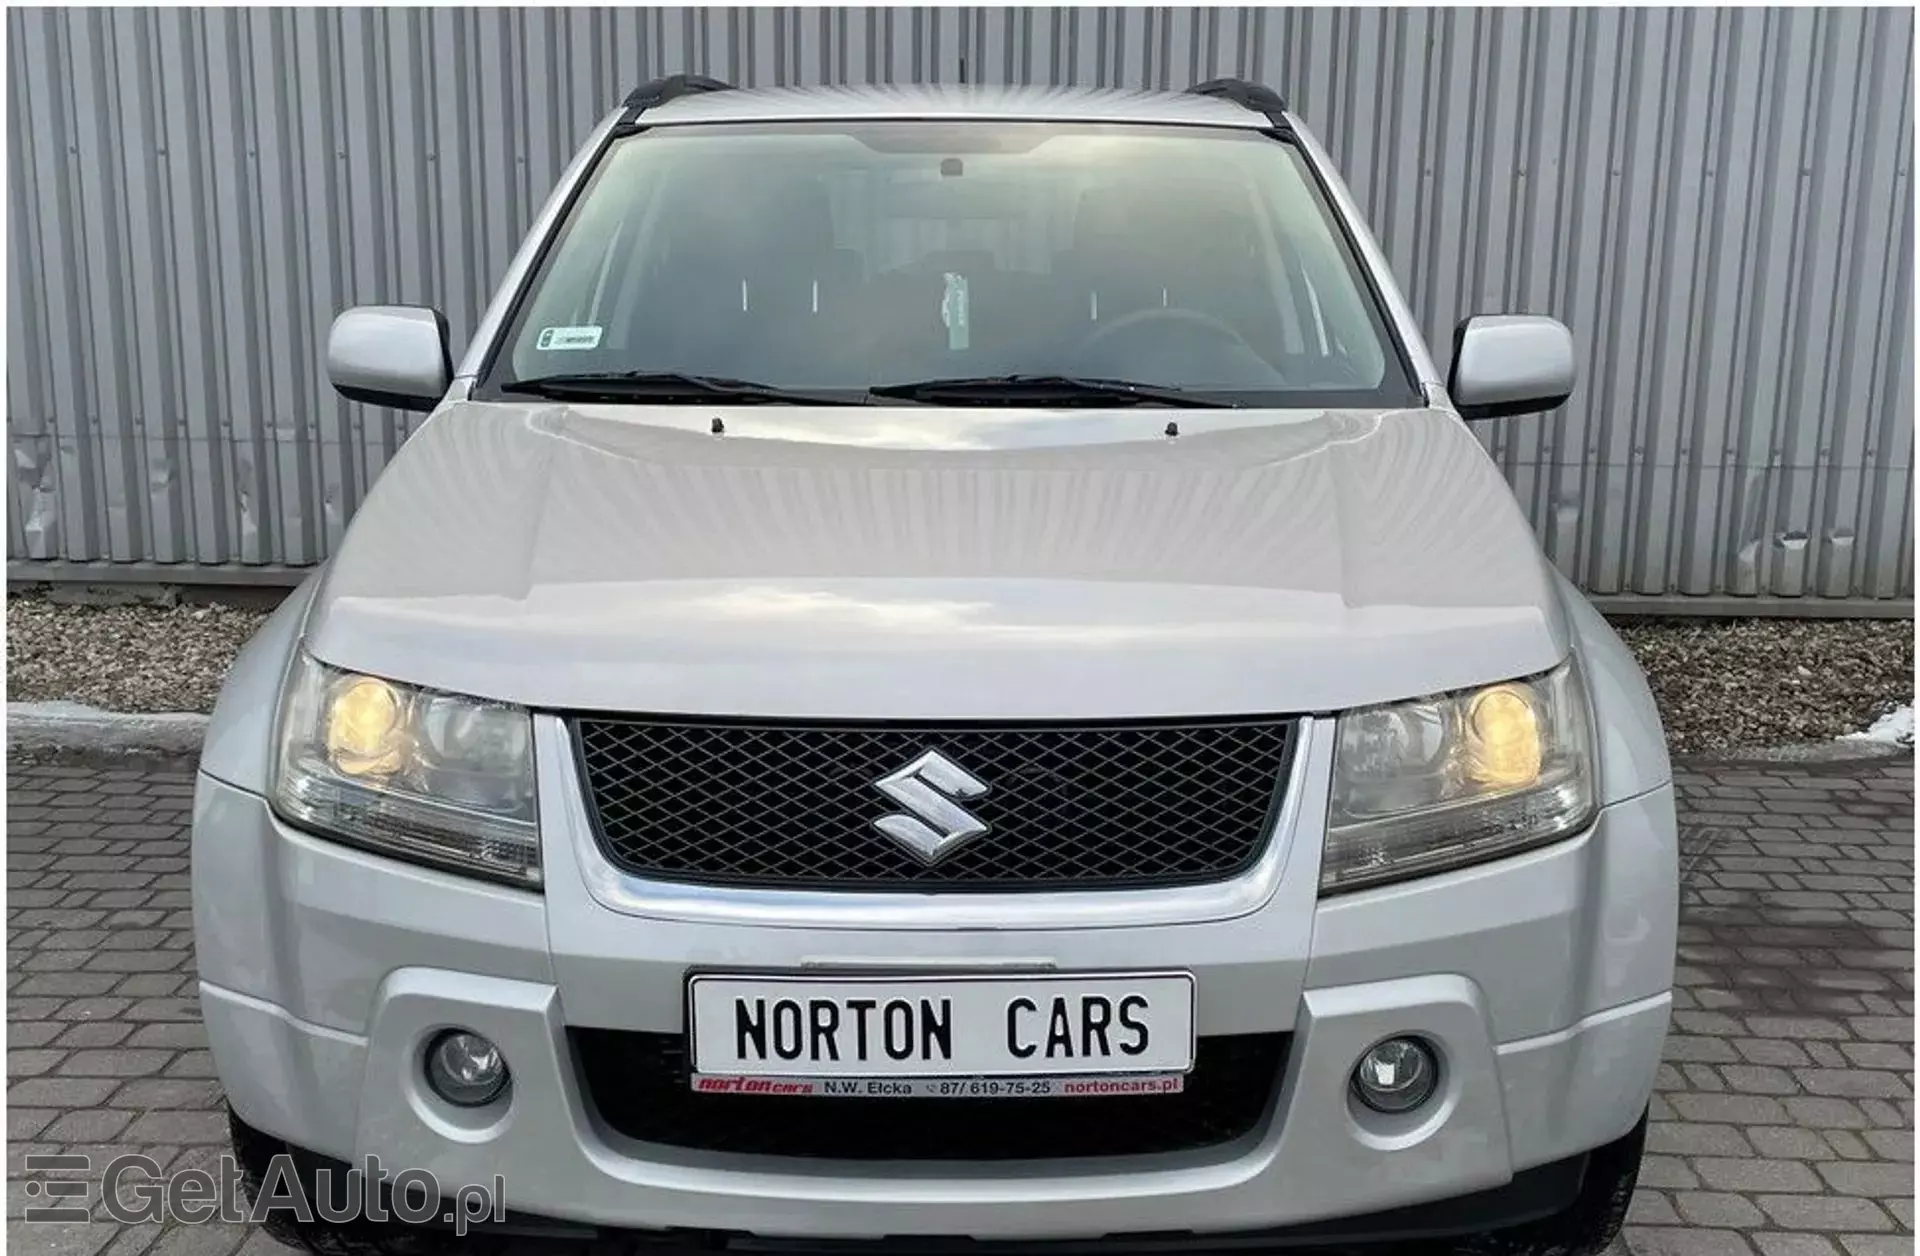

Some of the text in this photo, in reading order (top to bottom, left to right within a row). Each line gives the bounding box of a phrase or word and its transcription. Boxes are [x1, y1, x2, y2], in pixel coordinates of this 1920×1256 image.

[735, 996, 1149, 1060] NORTON CARS
[824, 1081, 863, 1093] N.W.
[1064, 1078, 1178, 1094] nortoncars.pl
